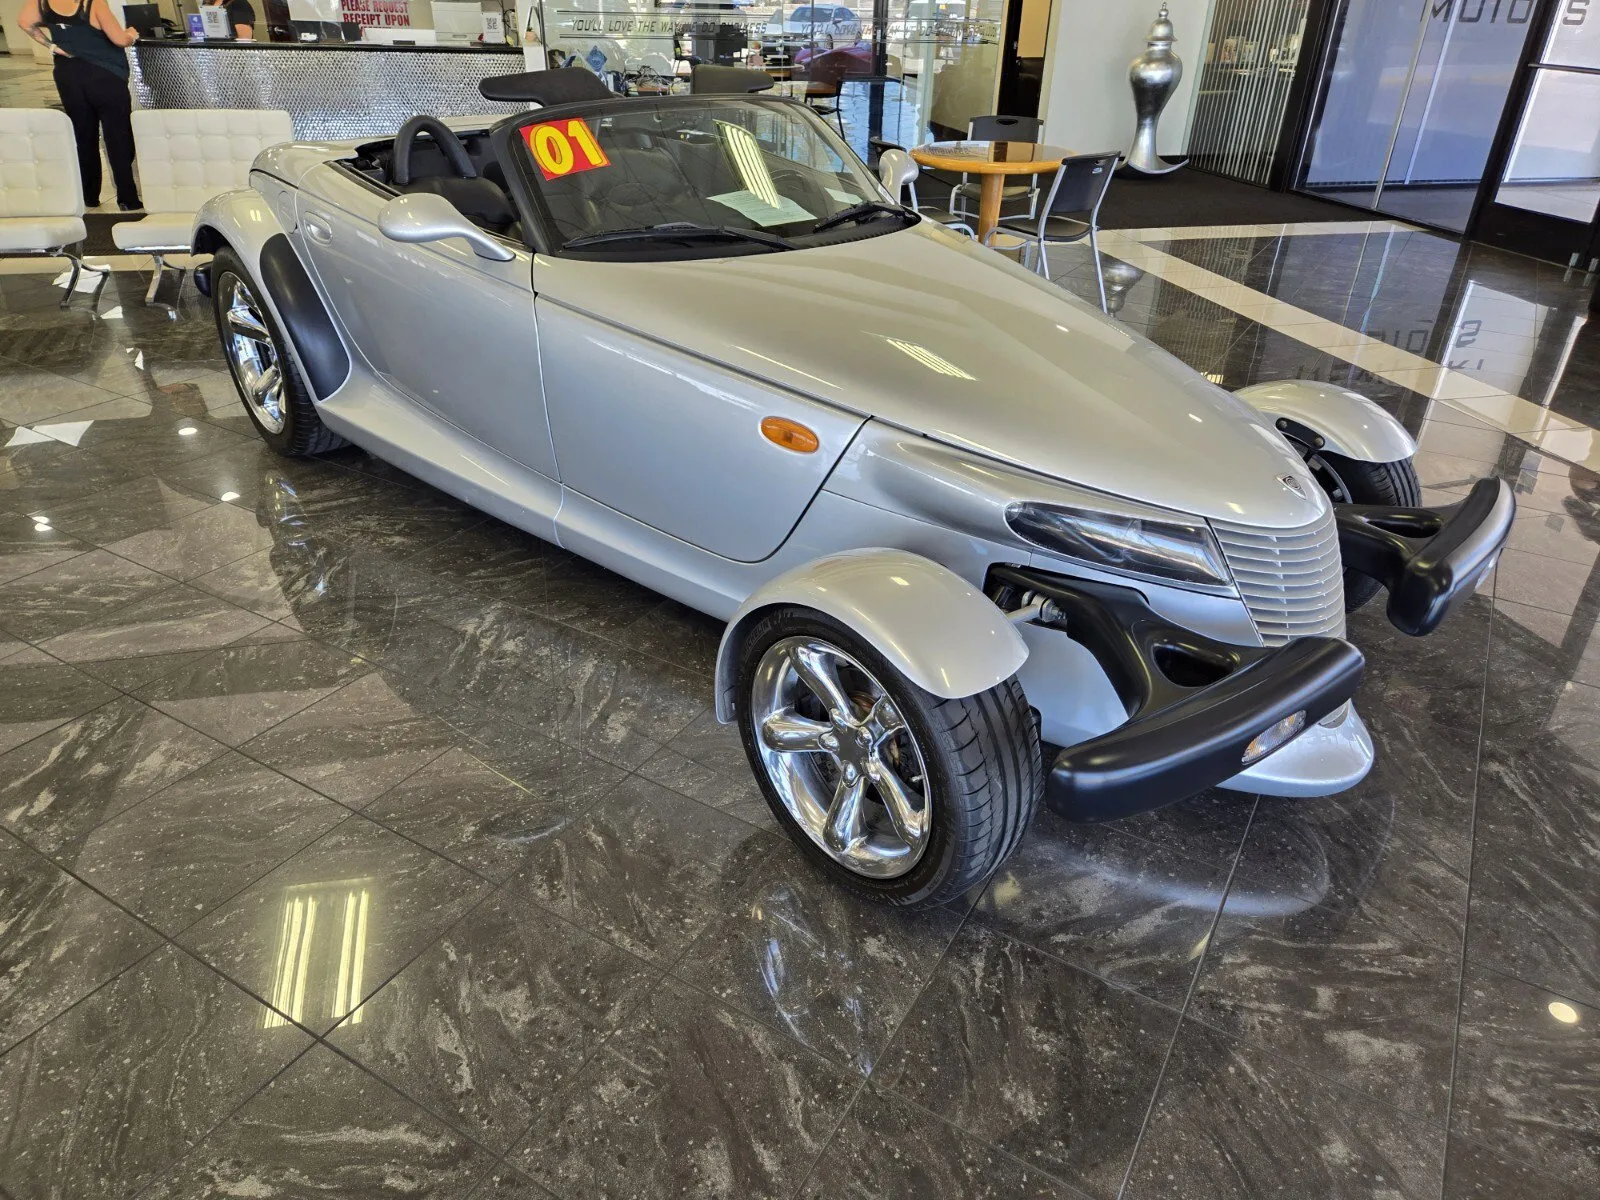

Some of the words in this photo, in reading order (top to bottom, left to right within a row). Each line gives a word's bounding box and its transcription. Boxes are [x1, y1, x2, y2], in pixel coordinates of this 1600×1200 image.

[341, 0, 371, 11] PLEASE
[373, 1, 409, 13] REQUEST
[1420, 0, 1591, 25] MOTOS
[342, 13, 381, 25] RECEIPT
[384, 14, 411, 26] UPON
[571, 18, 603, 32] YOU'LL
[608, 20, 635, 32] LOVE
[638, 20, 656, 33] THE
[701, 22, 716, 33] DO
[530, 120, 608, 175] 01
